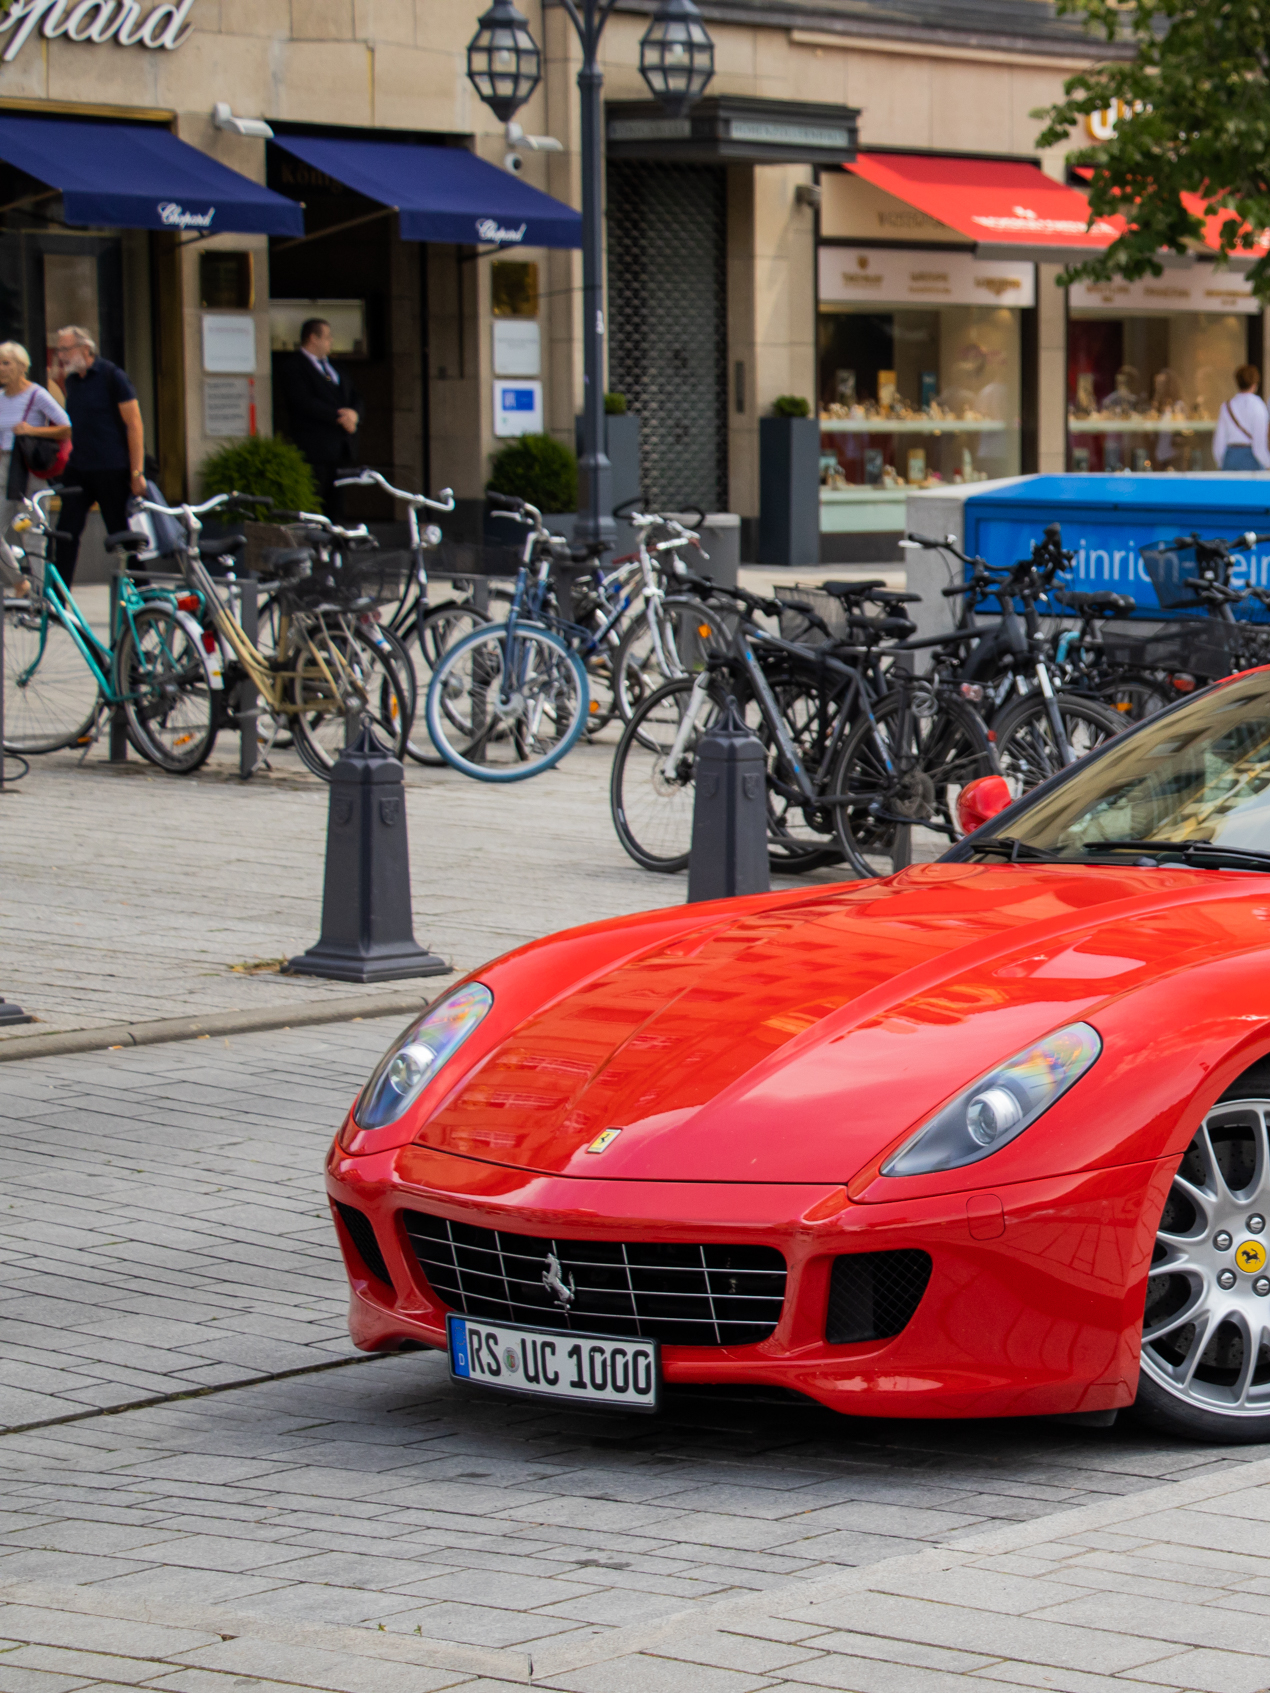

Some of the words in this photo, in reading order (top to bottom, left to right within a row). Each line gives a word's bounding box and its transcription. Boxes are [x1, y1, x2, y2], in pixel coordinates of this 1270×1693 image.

[157, 201, 216, 230] Chopard
[475, 218, 528, 245] Chopard
[468, 1327, 502, 1377] RS
[520, 1337, 560, 1386] UC
[567, 1343, 653, 1395] 1000
